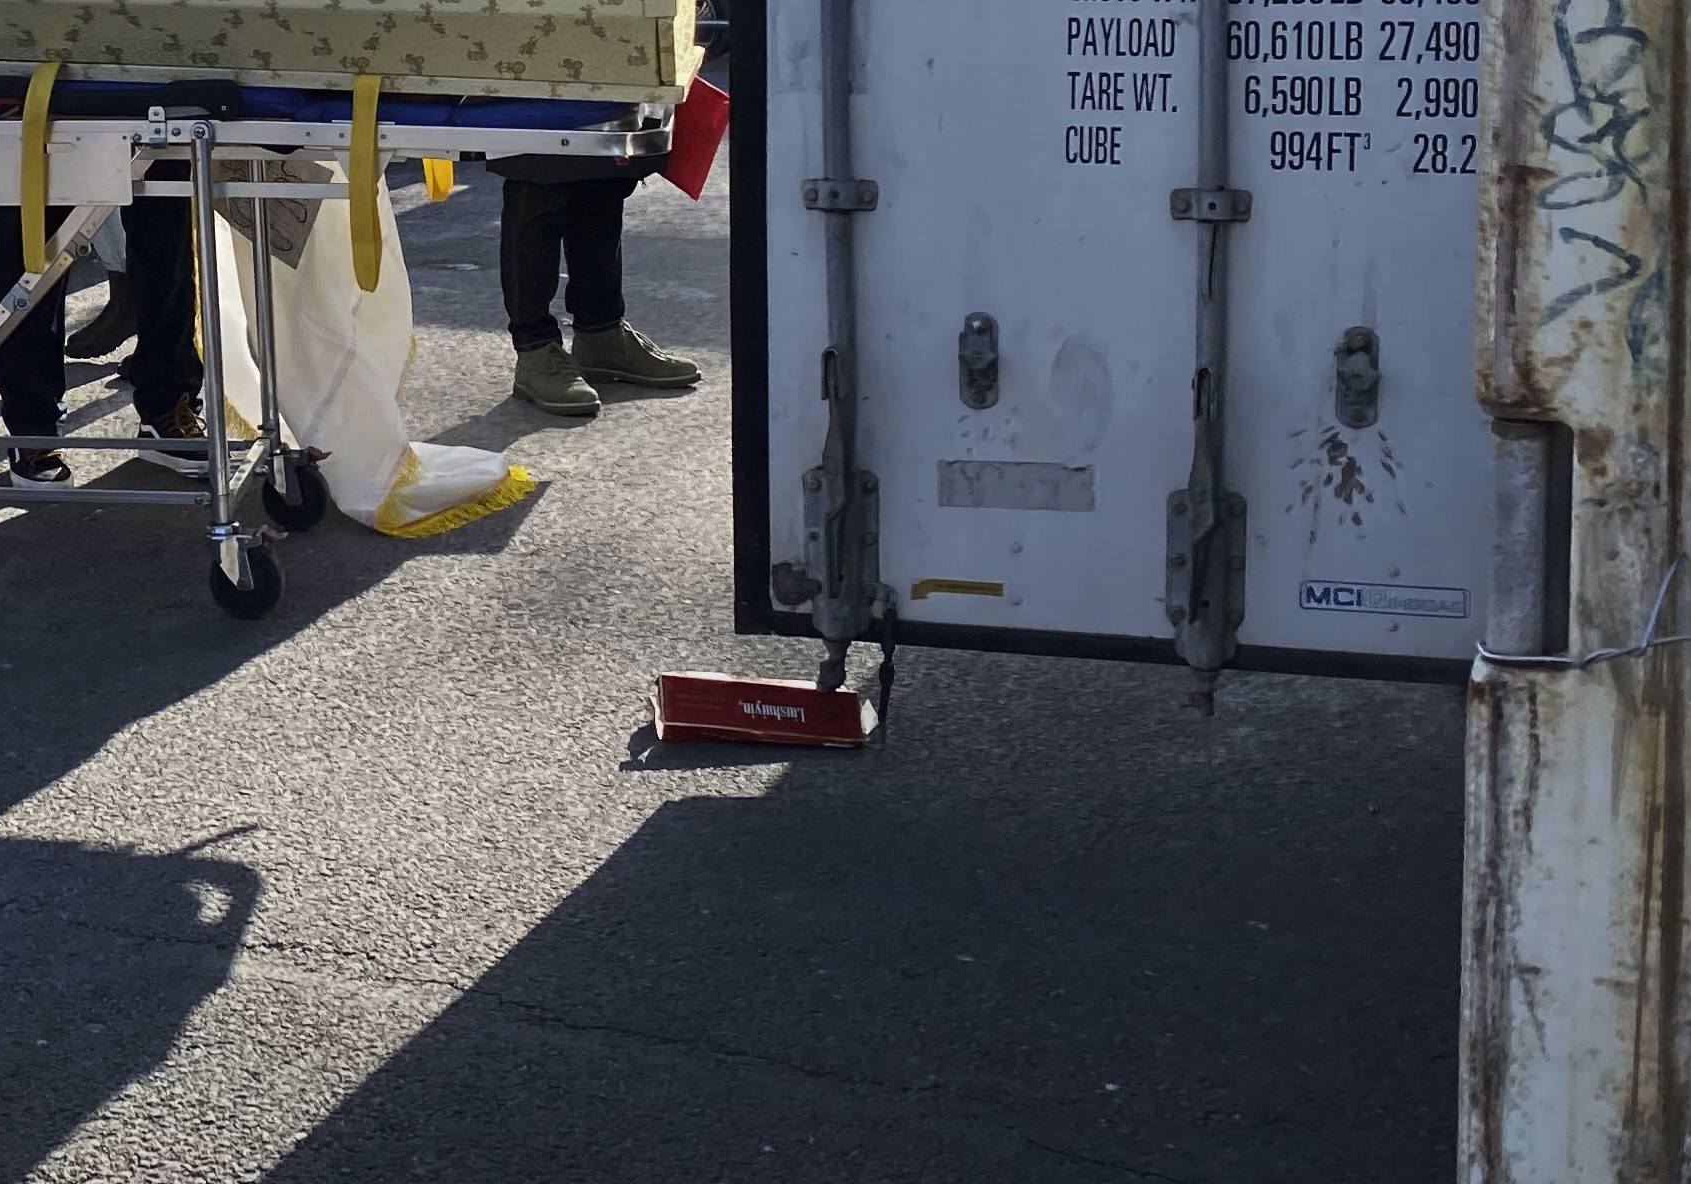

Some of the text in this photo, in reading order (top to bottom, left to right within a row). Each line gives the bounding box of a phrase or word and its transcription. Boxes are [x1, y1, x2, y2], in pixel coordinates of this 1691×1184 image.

[1067, 17, 1176, 58] PAYLOAD
[1378, 20, 1480, 65] 27,490
[1067, 71, 1125, 111] TARE
[1132, 72, 1178, 113] WT.
[1395, 77, 1479, 121] 2,990
[1065, 125, 1122, 165] CUBE
[1412, 133, 1477, 175] 28.2
[1305, 585, 1362, 608] MCI
